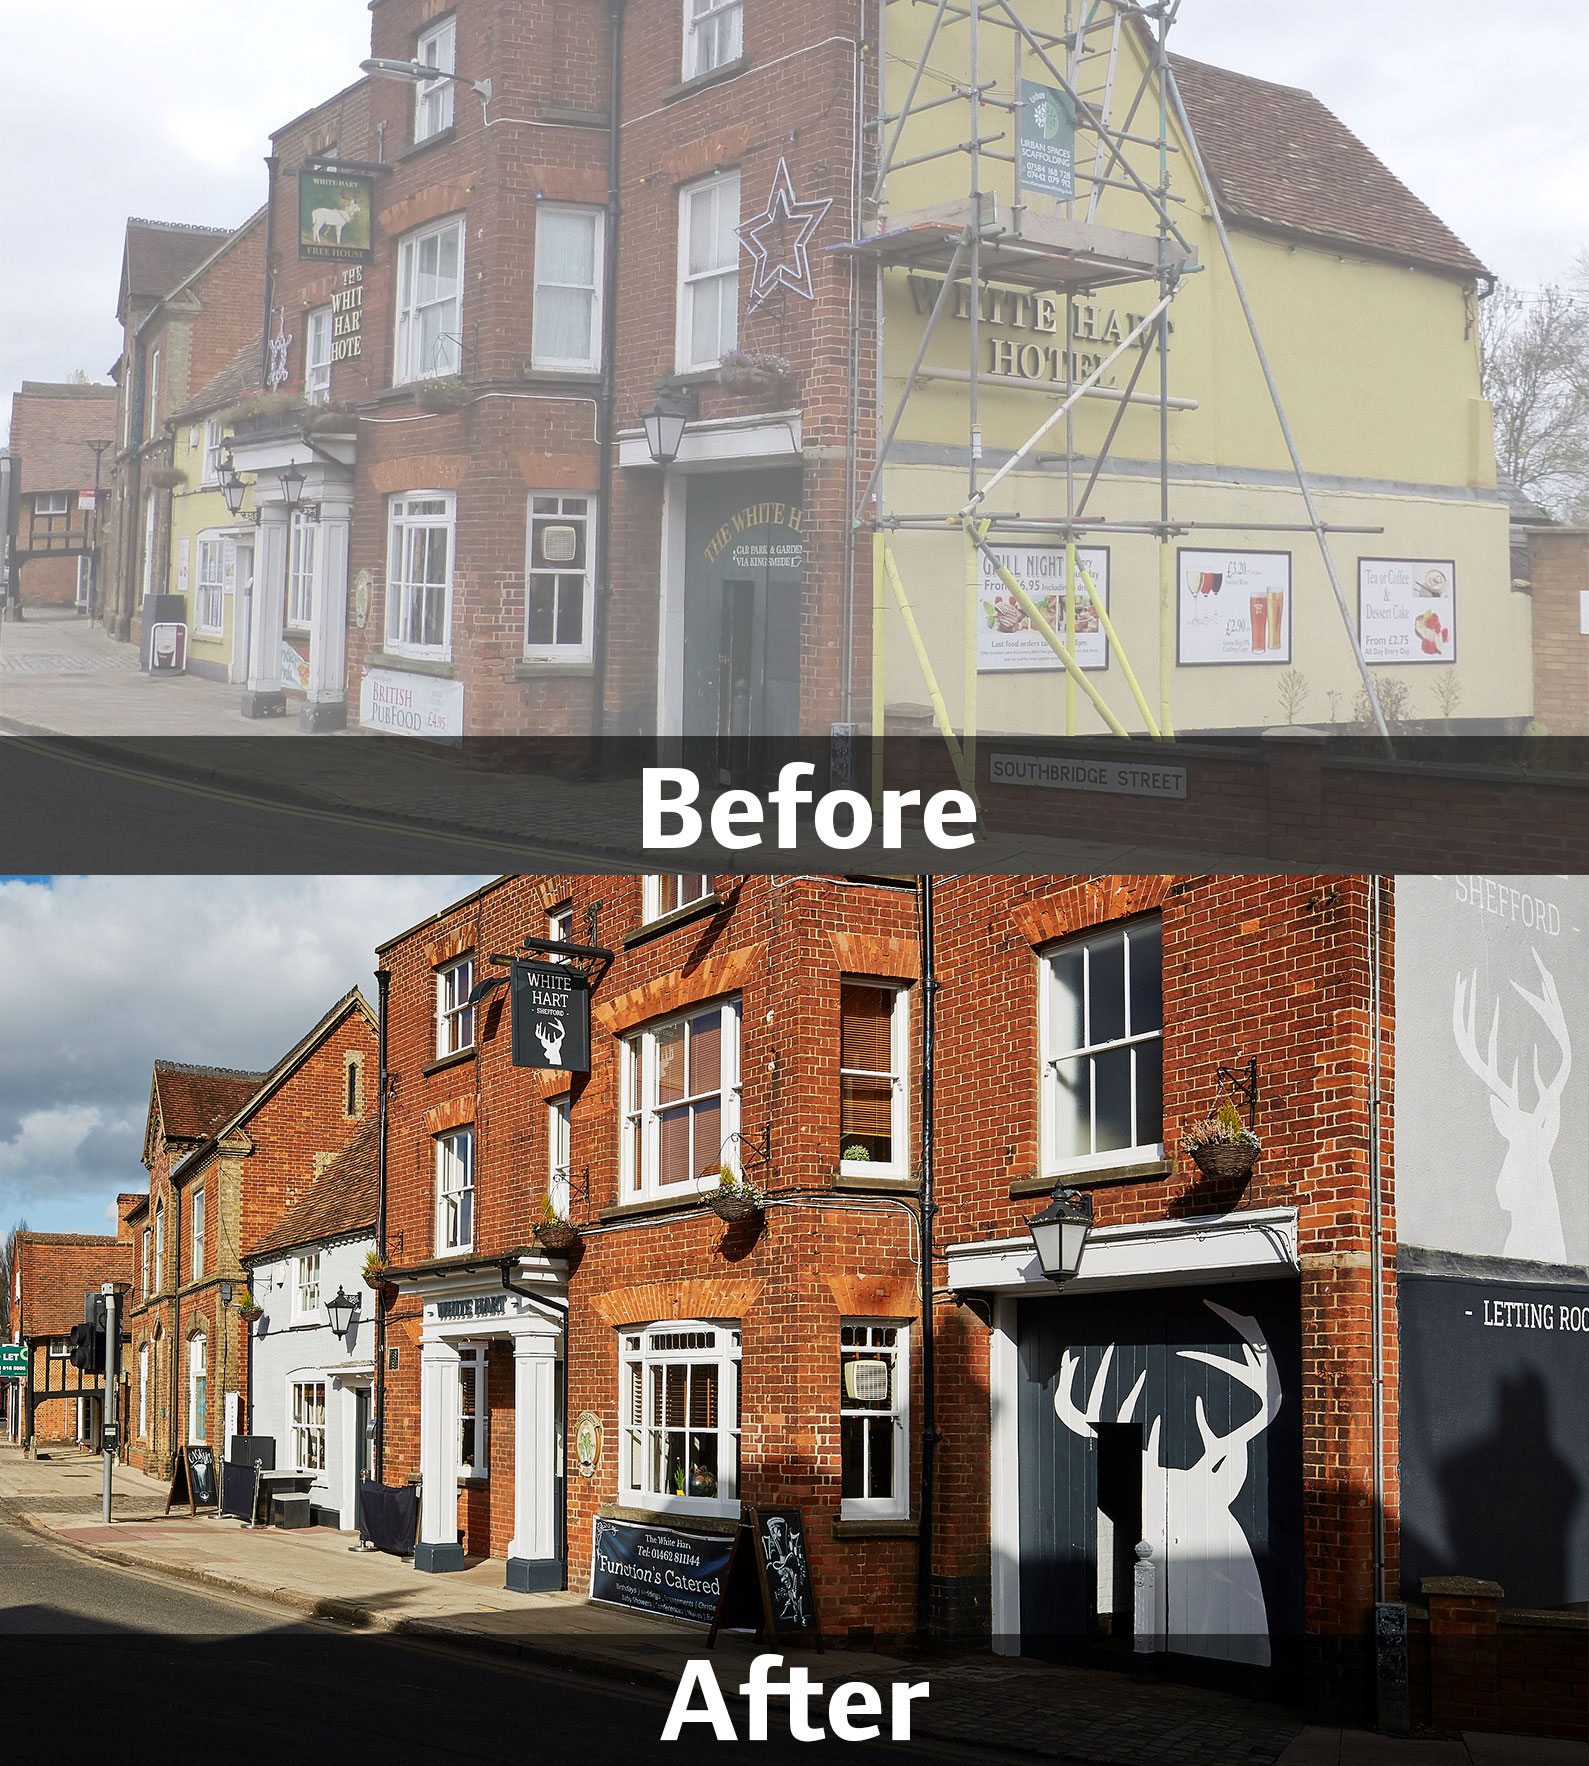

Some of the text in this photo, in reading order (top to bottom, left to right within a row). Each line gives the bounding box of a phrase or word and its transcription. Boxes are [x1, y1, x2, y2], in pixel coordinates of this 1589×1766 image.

[1021, 138, 1071, 158] URBAN SPACES
[1022, 148, 1070, 167] SCAFFOLDING
[312, 177, 359, 188] WHITE HART
[306, 246, 364, 259] FREE HOUSE
[703, 522, 733, 566] THE
[730, 502, 785, 534] WHITE
[736, 545, 750, 555] CAR
[751, 545, 768, 555] PARK
[1026, 555, 1064, 577] NIGHT
[1018, 580, 1040, 591] 6.95
[1041, 583, 1068, 592] Includin
[1365, 569, 1410, 585] Tea or Coffee
[1383, 587, 1390, 602] &
[1365, 604, 1410, 620] Dessert Cake
[991, 640, 1005, 648] Last
[1005, 640, 1018, 648] food
[1020, 639, 1040, 647] orders
[1365, 635, 1387, 645] From
[373, 681, 413, 708] BRITISH
[993, 761, 1183, 791] SOUTHBRIDGE STREET
[1455, 875, 1561, 936] SHEFFORD
[527, 972, 571, 991] WHITE
[532, 990, 568, 1007] HART
[437, 1295, 508, 1318] WHITE HART
[1483, 1299, 1554, 1330] LETTING
[2, 1353, 19, 1362] LET
[645, 1534, 657, 1545] The
[658, 1536, 676, 1547] White
[637, 1545, 700, 1567] Tel: 01462 811144
[600, 1554, 720, 1596] Function's Catered
